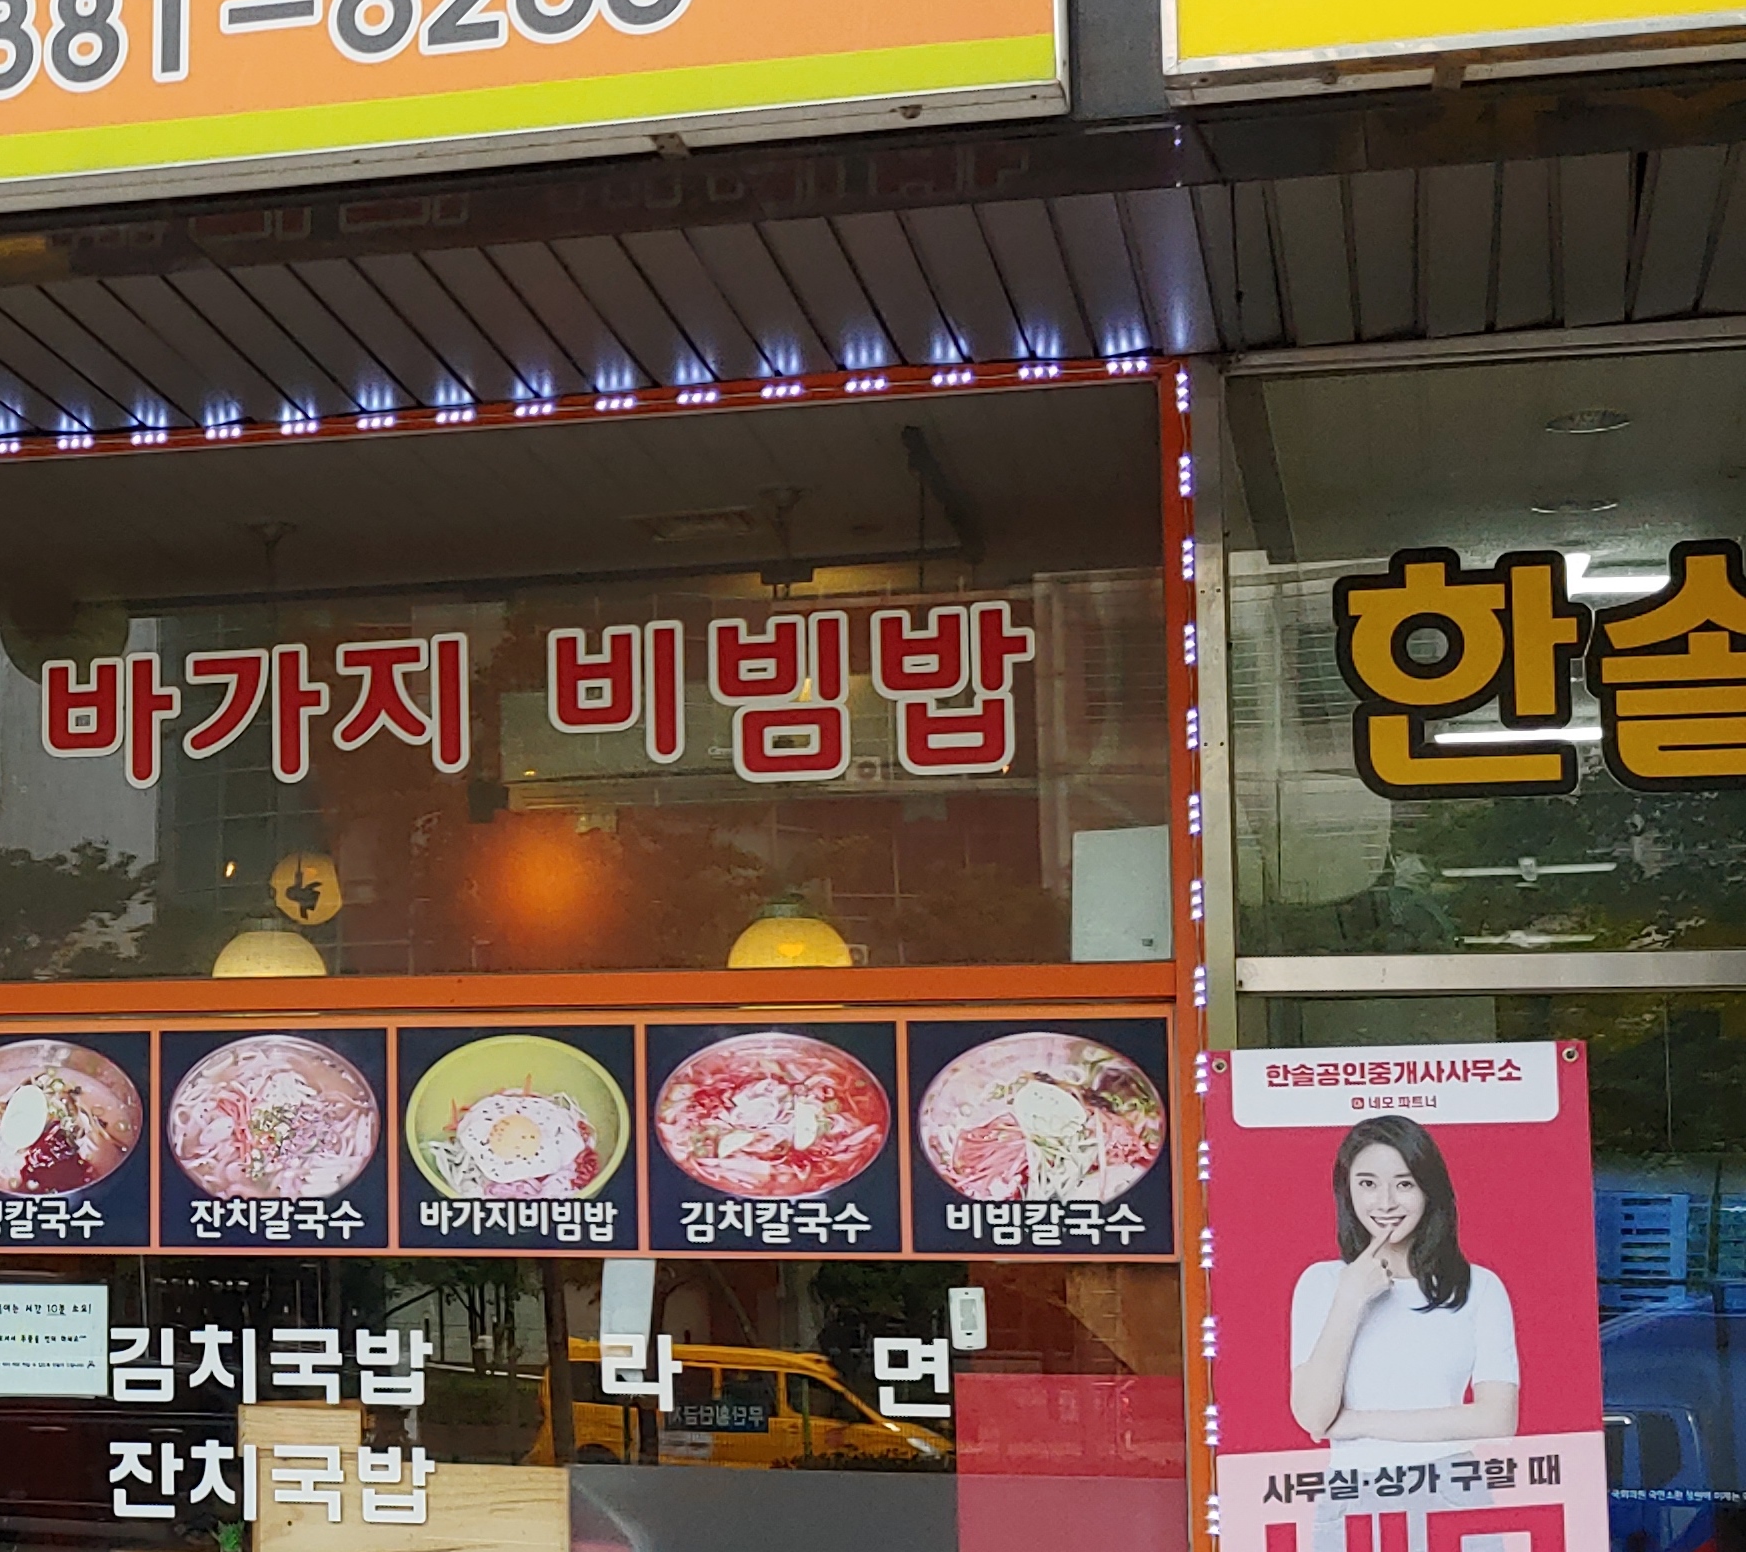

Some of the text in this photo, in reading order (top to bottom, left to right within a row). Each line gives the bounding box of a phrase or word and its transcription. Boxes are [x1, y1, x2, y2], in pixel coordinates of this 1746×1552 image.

[1332, 538, 1746, 799] 한솔
[41, 599, 1036, 791] 바가지 비빔밥
[1265, 1058, 1523, 1088] 한솔공인중개사사무소
[1368, 1095, 1437, 1109] 네모 파트너
[189, 1199, 366, 1240] 잔치칼국수
[420, 1199, 618, 1242] 바가지비빔밥
[679, 1200, 872, 1244] 김치칼국수
[945, 1201, 1146, 1246] 비빔칼국수
[108, 1323, 433, 1407] 김치국밥
[108, 1439, 435, 1525] 잔치국밥
[1450, 1457, 1518, 1491] 구할
[1528, 1454, 1562, 1487] 때
